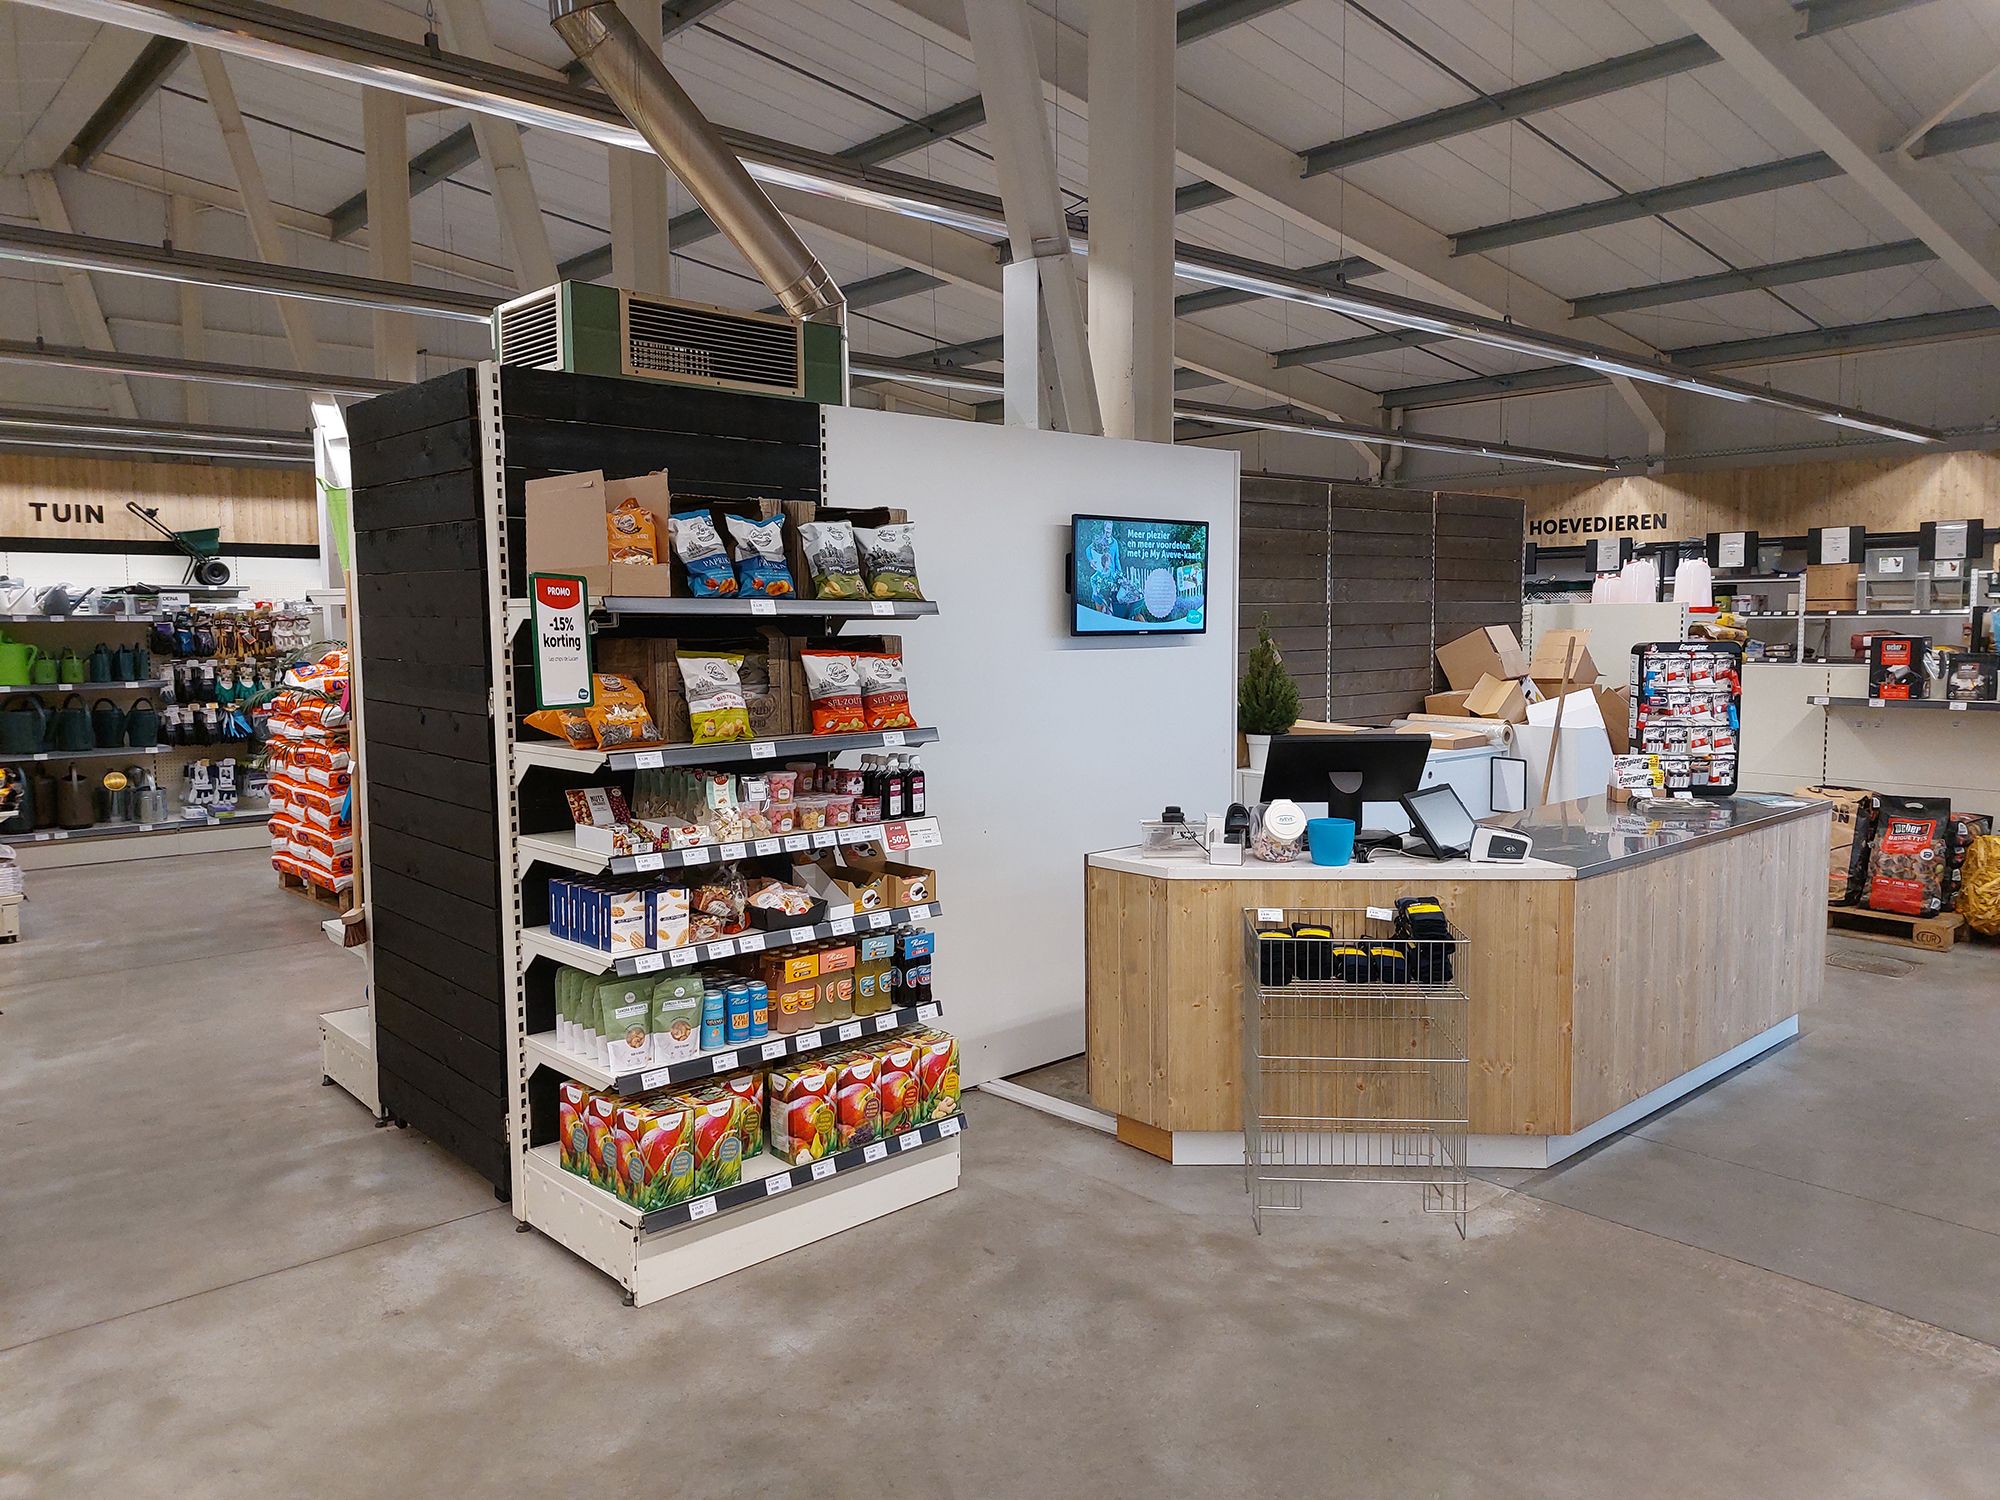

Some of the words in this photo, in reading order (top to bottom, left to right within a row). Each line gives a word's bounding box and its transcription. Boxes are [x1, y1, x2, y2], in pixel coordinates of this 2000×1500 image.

[28, 502, 104, 523] TUIN
[1529, 513, 1667, 535] HOEVEDIEREN
[1127, 529, 1145, 539] Meer
[1146, 530, 1171, 541] plezier
[1137, 541, 1155, 549] meer
[1156, 541, 1191, 551] voordelen
[1127, 549, 1141, 558] met
[1141, 550, 1149, 559] je
[1150, 549, 1160, 560] My
[1161, 550, 1201, 560] Aveve-kaart
[547, 586, 571, 597] PROMO
[549, 616, 574, 632] -15%
[543, 633, 581, 652] korting
[1679, 643, 1709, 652] Energizer
[716, 694, 737, 702] BISTER
[1614, 757, 1644, 768] Energizer
[1618, 773, 1648, 784] Energizer
[589, 794, 605, 802] NUTS
[1895, 823, 1922, 834] weber
[889, 834, 909, 844] -50%
[1888, 835, 1928, 843] BRIQUETTES
[1920, 933, 1938, 943] EUR
[754, 1009, 768, 1017] COL
